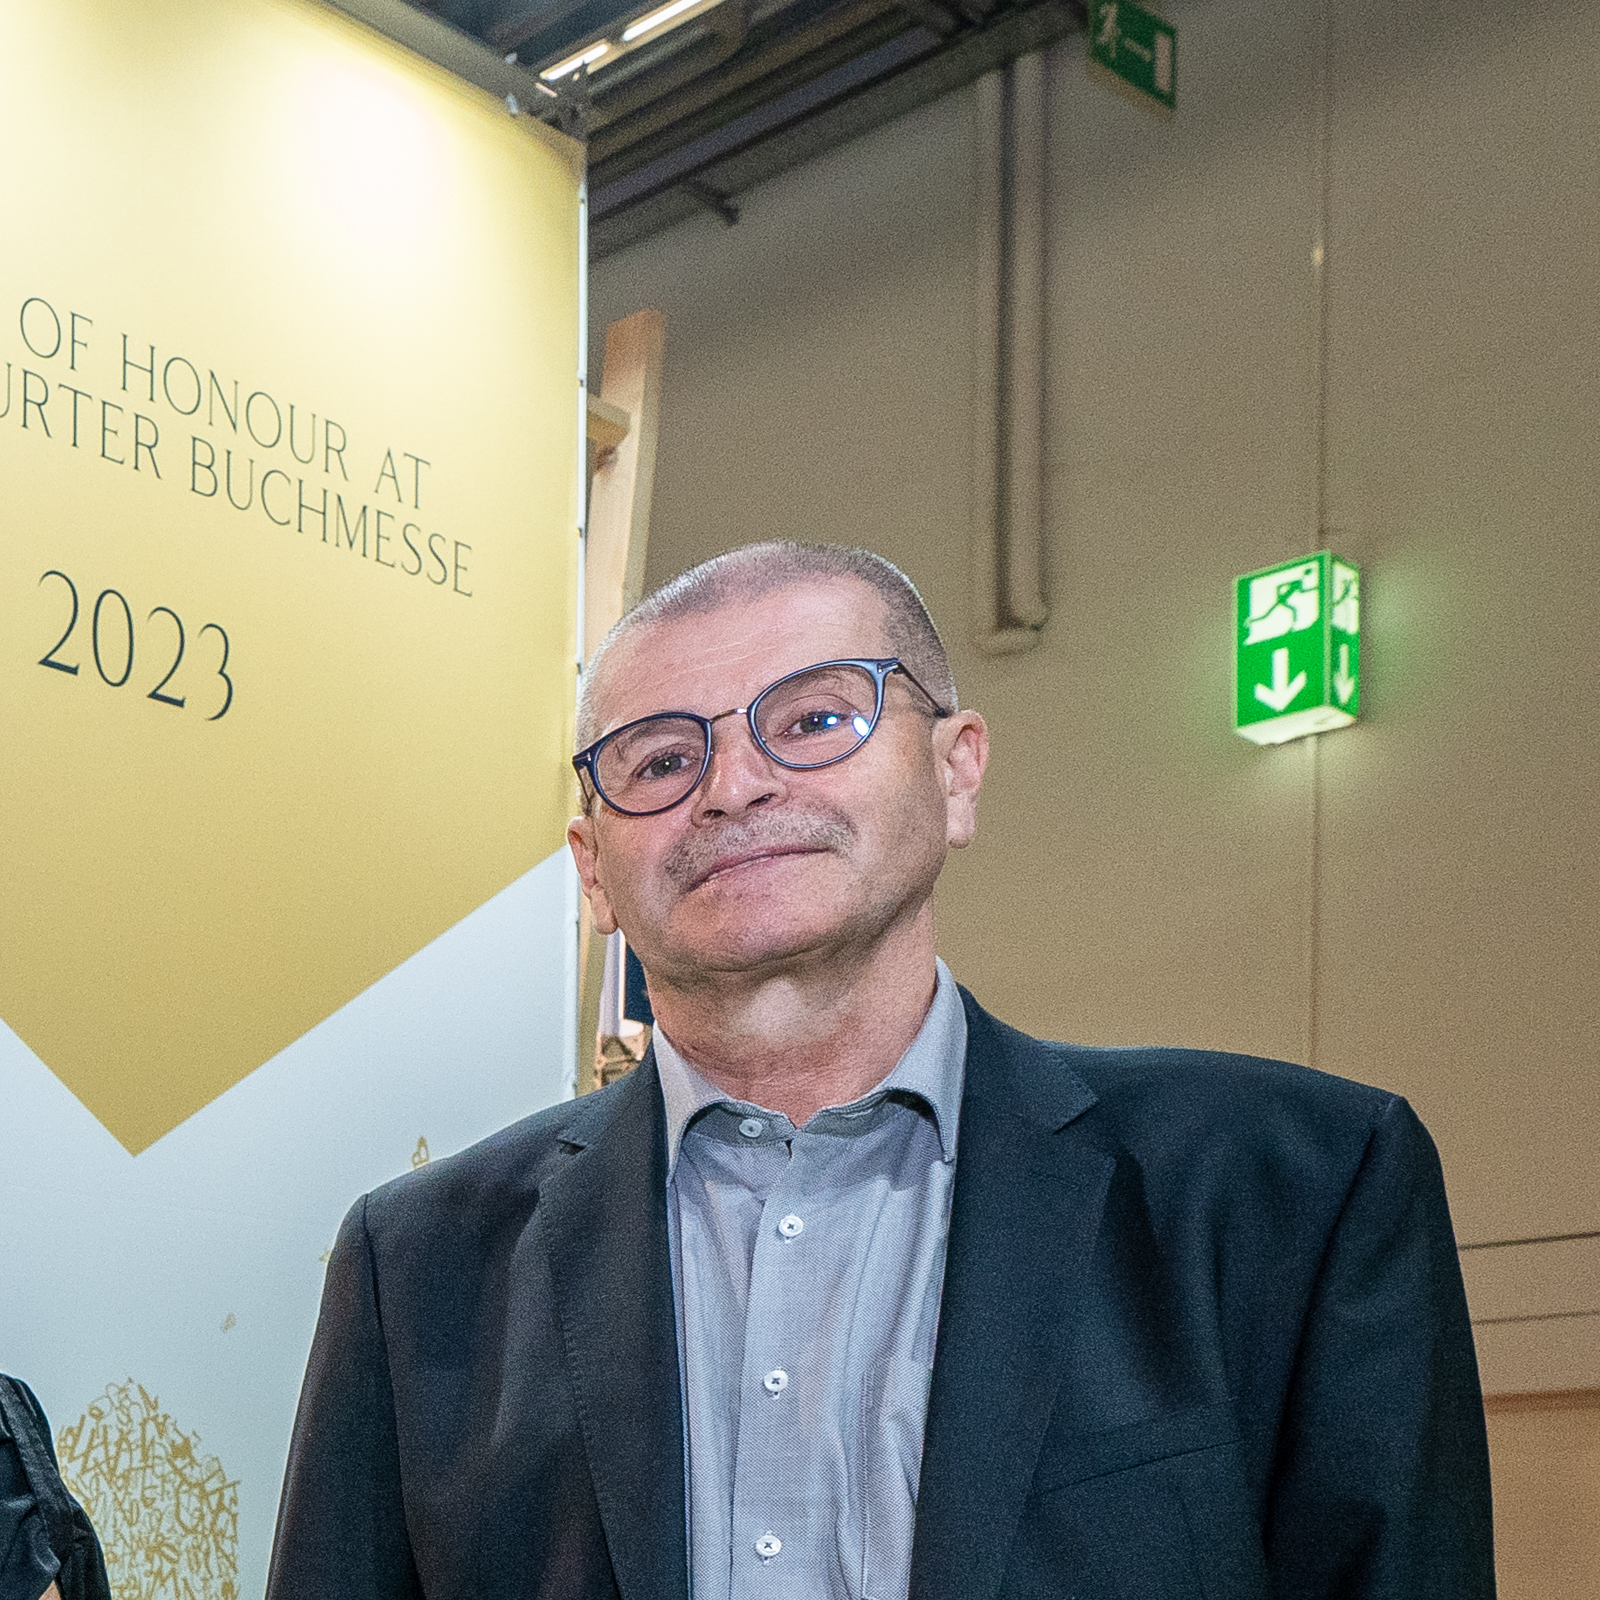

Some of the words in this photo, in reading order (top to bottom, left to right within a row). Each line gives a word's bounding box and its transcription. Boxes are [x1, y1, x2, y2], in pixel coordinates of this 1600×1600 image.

[19, 297, 94, 371] OF
[120, 332, 350, 482] HONOUR
[374, 447, 432, 510] AT
[189, 434, 473, 598] BUCHMESSE
[37, 569, 234, 721] 2023
